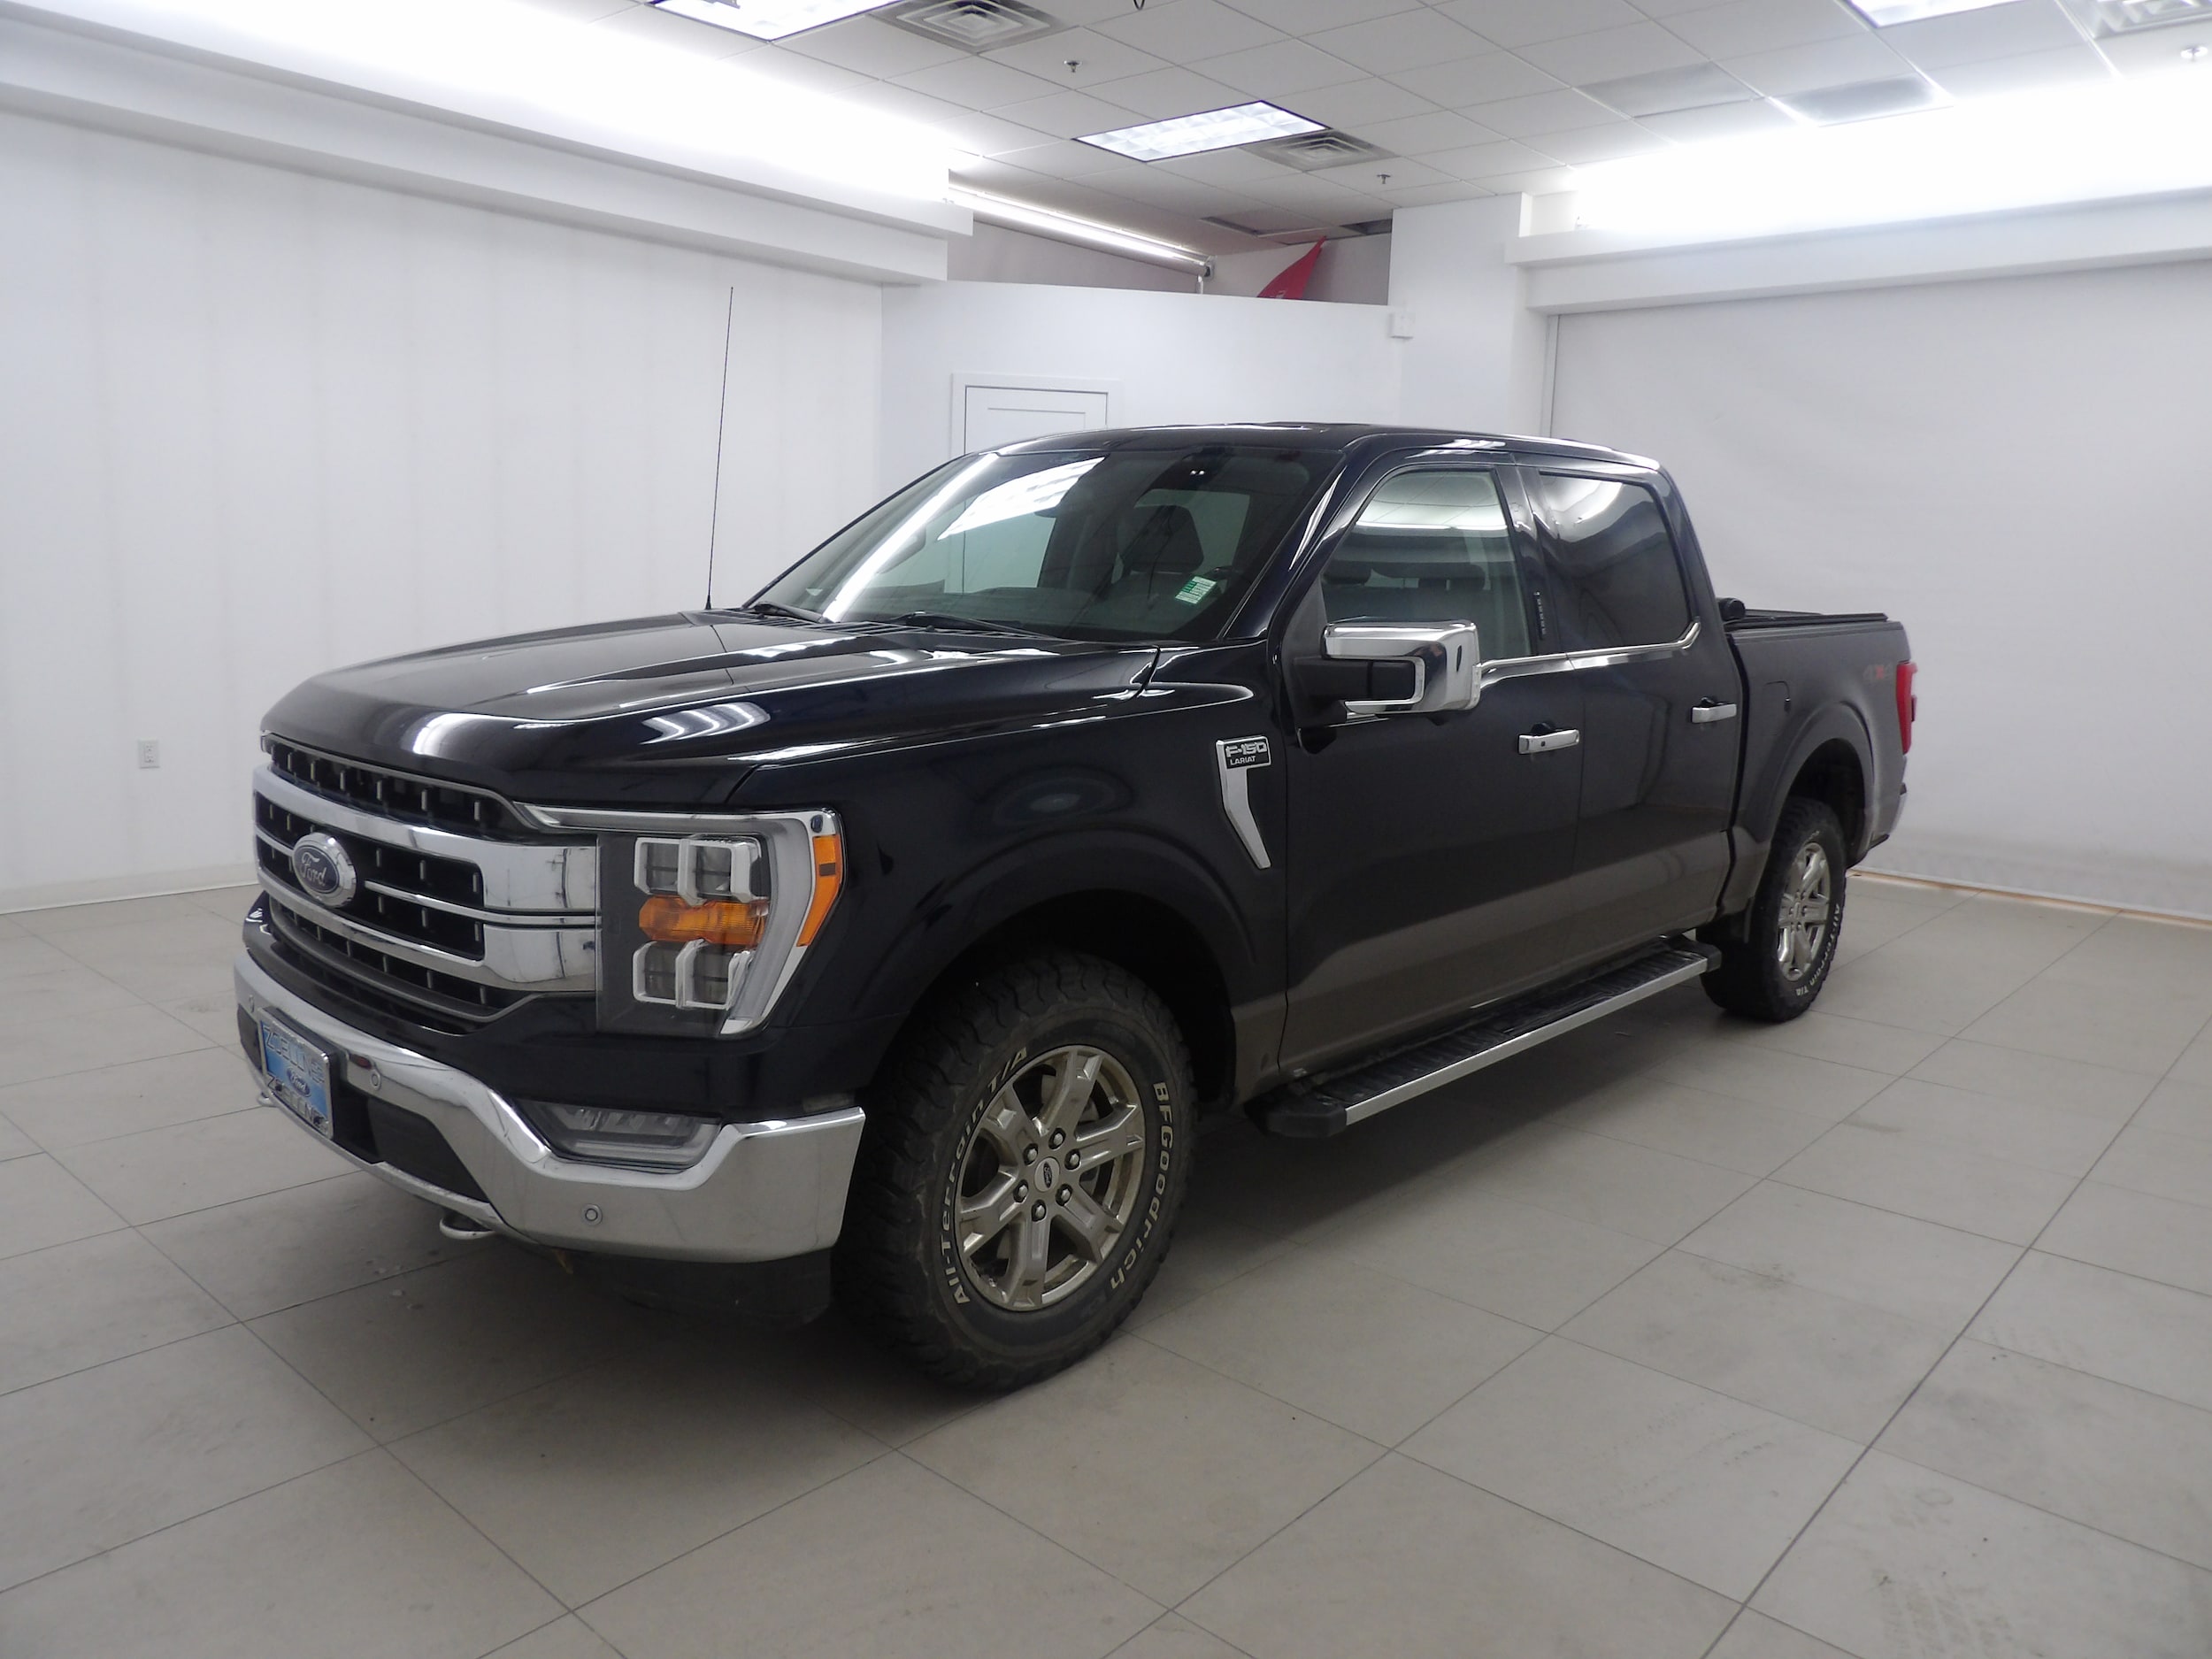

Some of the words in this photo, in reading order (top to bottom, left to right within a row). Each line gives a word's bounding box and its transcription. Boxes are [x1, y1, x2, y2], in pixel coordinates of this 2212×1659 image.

[1225, 741, 1268, 758] F-150
[1229, 755, 1256, 766] LARIAT
[301, 851, 327, 887] Ford
[941, 1098, 984, 1305] All-Terrain
[987, 1046, 1027, 1094] T/A
[1110, 1081, 1174, 1290] BFGoodrich
